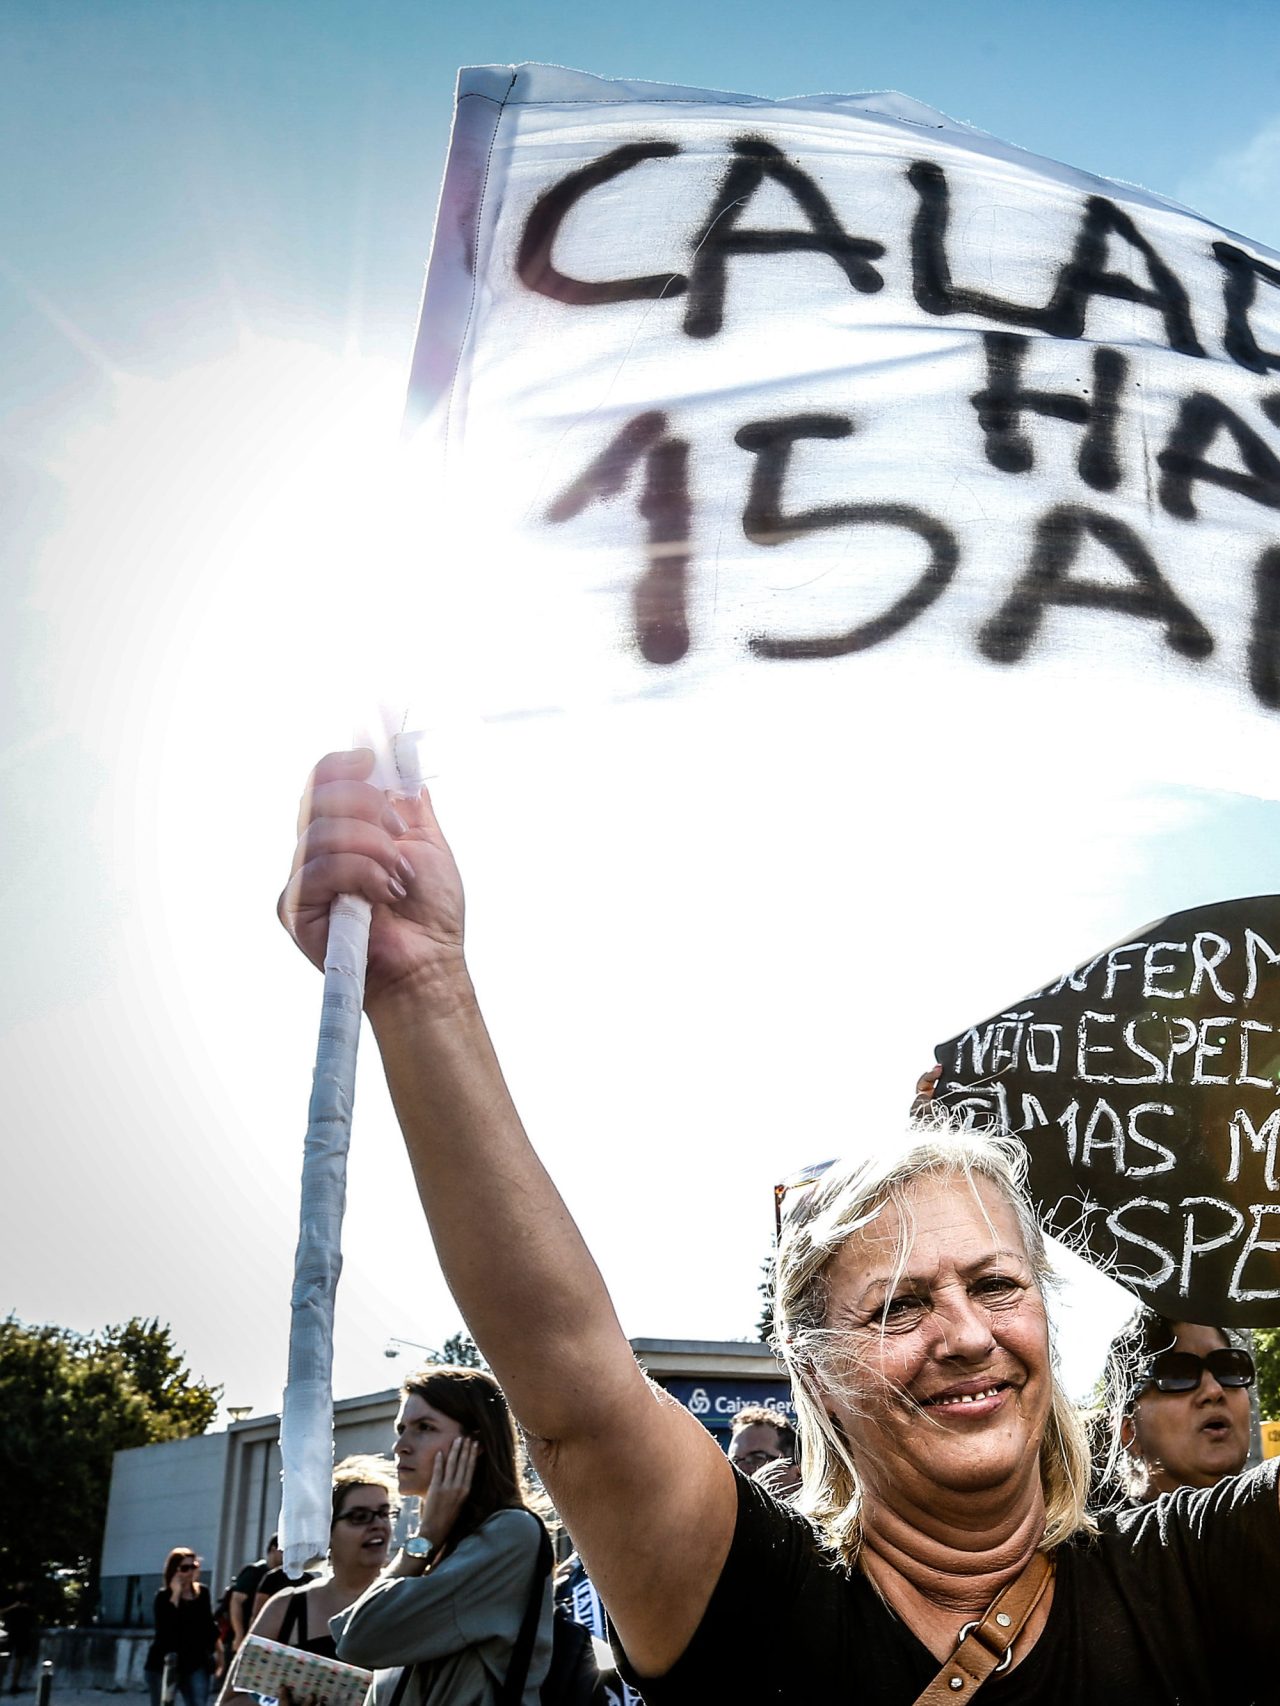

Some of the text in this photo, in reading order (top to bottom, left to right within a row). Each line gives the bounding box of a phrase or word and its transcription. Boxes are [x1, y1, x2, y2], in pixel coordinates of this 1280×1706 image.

[545, 410, 962, 666] 15
[954, 1010, 1063, 1074] NÃO
[763, 1397, 797, 1413] Ger
